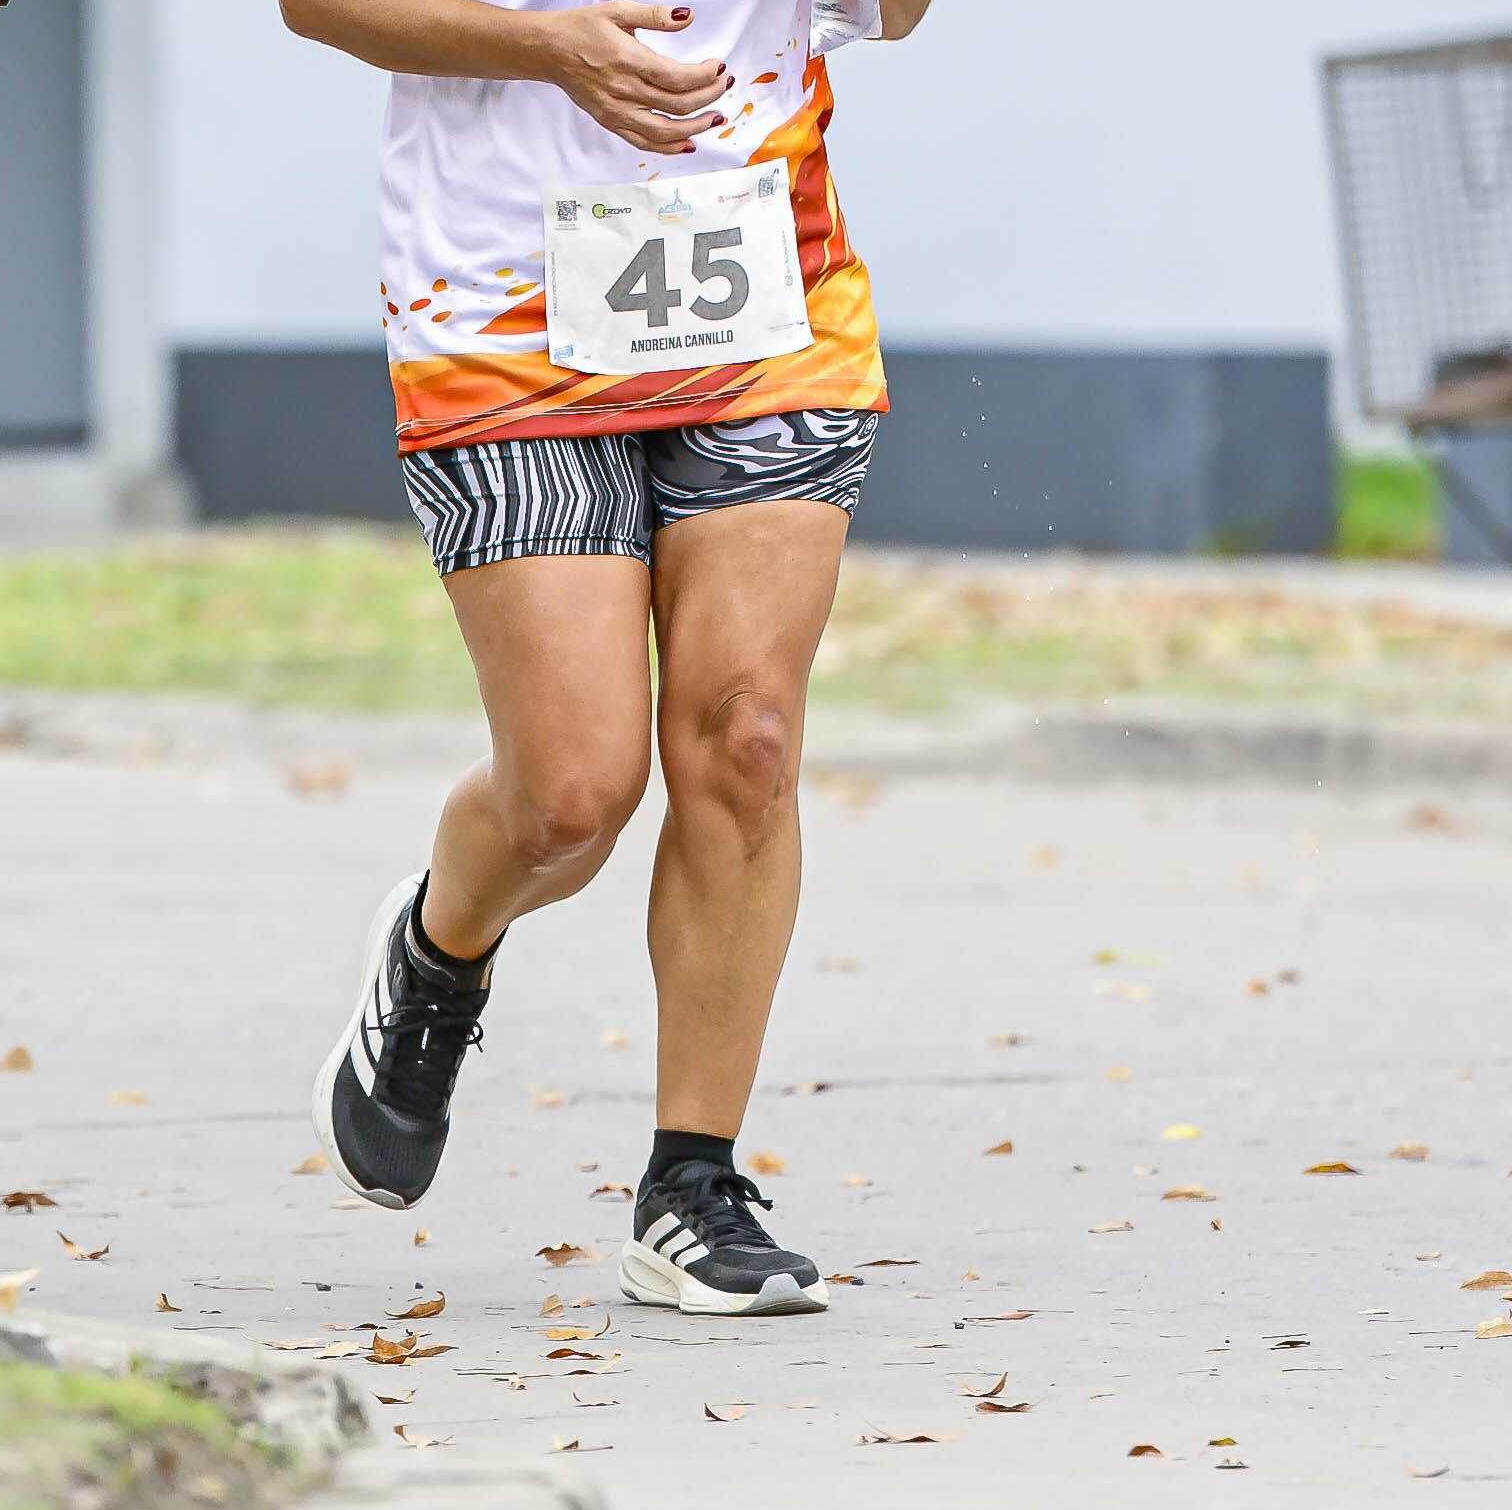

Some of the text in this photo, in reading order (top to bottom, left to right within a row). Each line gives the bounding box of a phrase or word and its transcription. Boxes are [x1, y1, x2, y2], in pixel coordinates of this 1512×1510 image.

[605, 226, 749, 327] 45
[630, 329, 734, 353] ANDREINA CANNILLO
